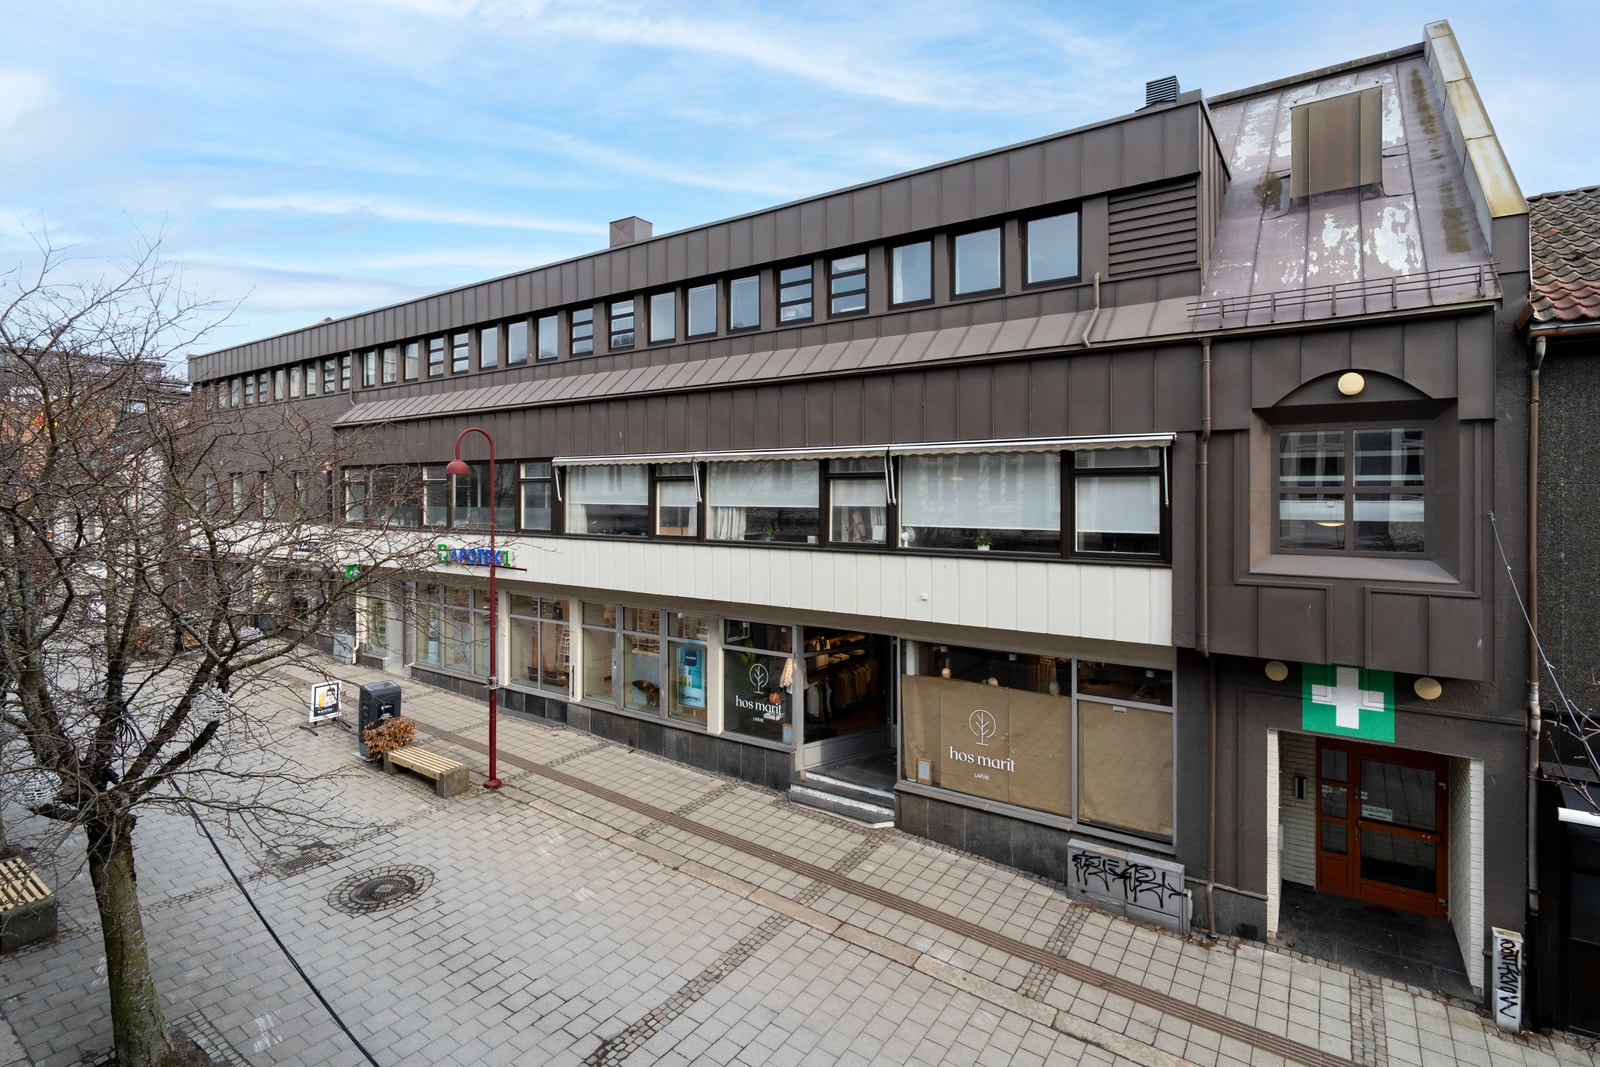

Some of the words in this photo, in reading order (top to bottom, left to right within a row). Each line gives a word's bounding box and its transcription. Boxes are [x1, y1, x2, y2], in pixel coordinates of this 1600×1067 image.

[451, 548, 502, 566] APOTEK
[503, 550, 511, 567] 1
[735, 695, 754, 709] hos
[755, 702, 782, 715] marit
[949, 746, 975, 764] hos
[977, 755, 1015, 772] marit
